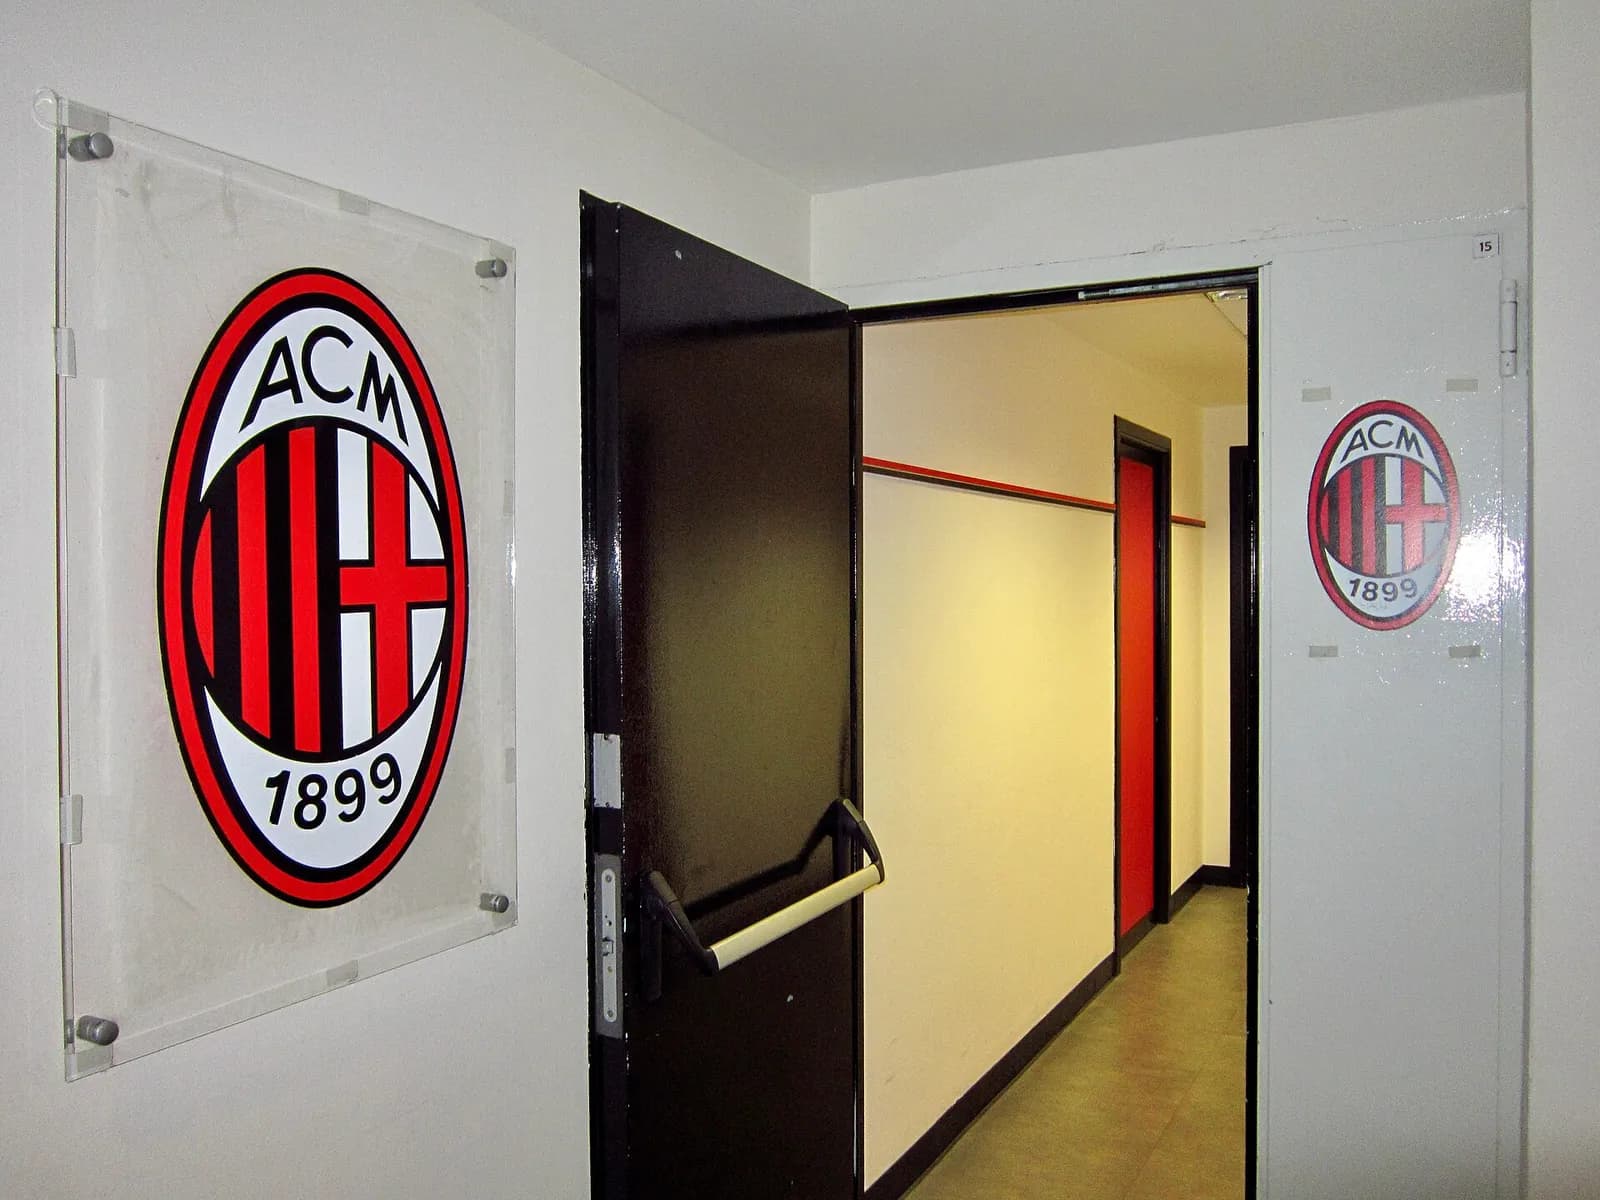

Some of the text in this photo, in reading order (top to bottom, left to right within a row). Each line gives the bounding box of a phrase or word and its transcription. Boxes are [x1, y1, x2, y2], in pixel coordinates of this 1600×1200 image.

[1480, 241, 1492, 252] 15
[238, 325, 408, 447] ACM
[1340, 420, 1424, 463] ACM
[1349, 578, 1417, 601] 1899
[265, 753, 402, 830] 1899
